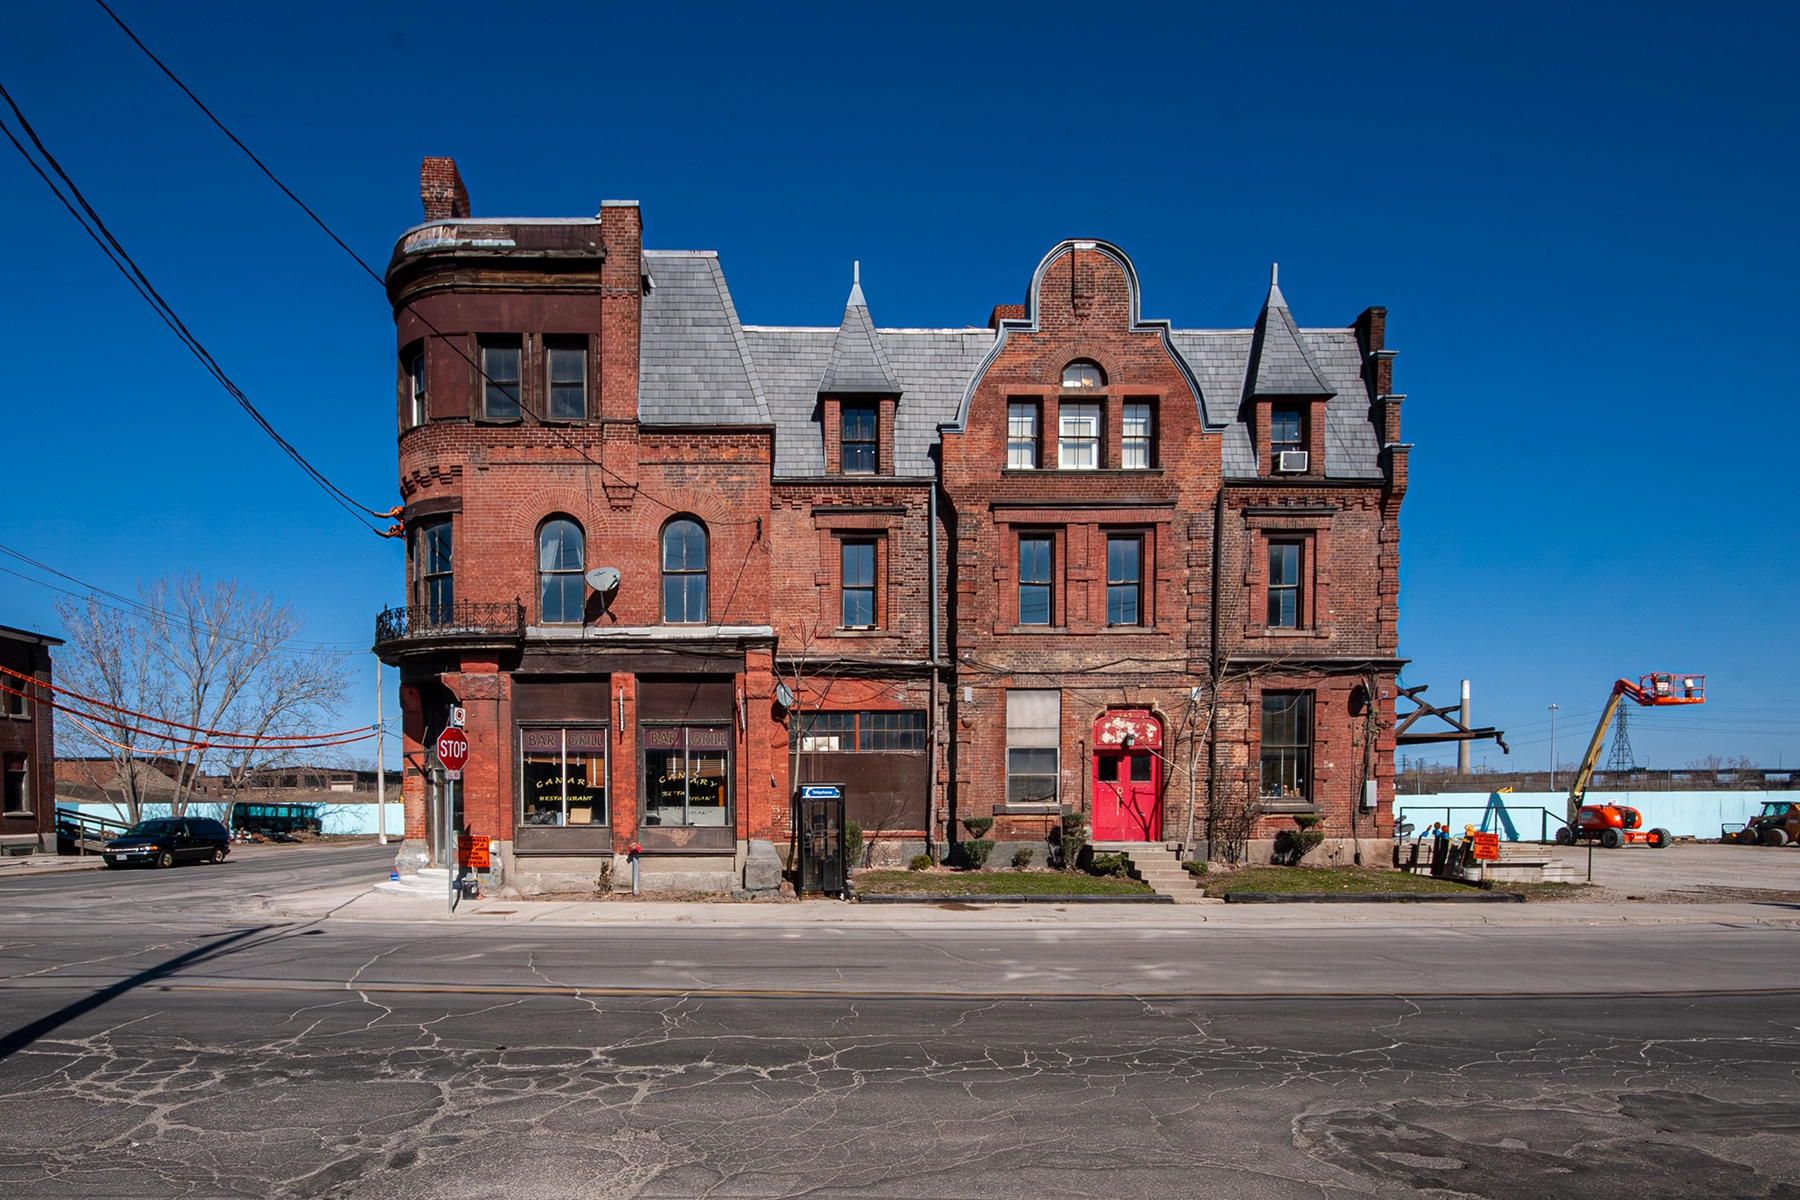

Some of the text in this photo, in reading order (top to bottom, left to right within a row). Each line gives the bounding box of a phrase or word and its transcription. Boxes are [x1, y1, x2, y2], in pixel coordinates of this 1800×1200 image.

[529, 733, 604, 748] BAR GRILL
[650, 731, 727, 746] BAR GRILL
[440, 739, 467, 758] STOP
[536, 777, 594, 788] CANARY
[659, 772, 717, 787] CANARY
